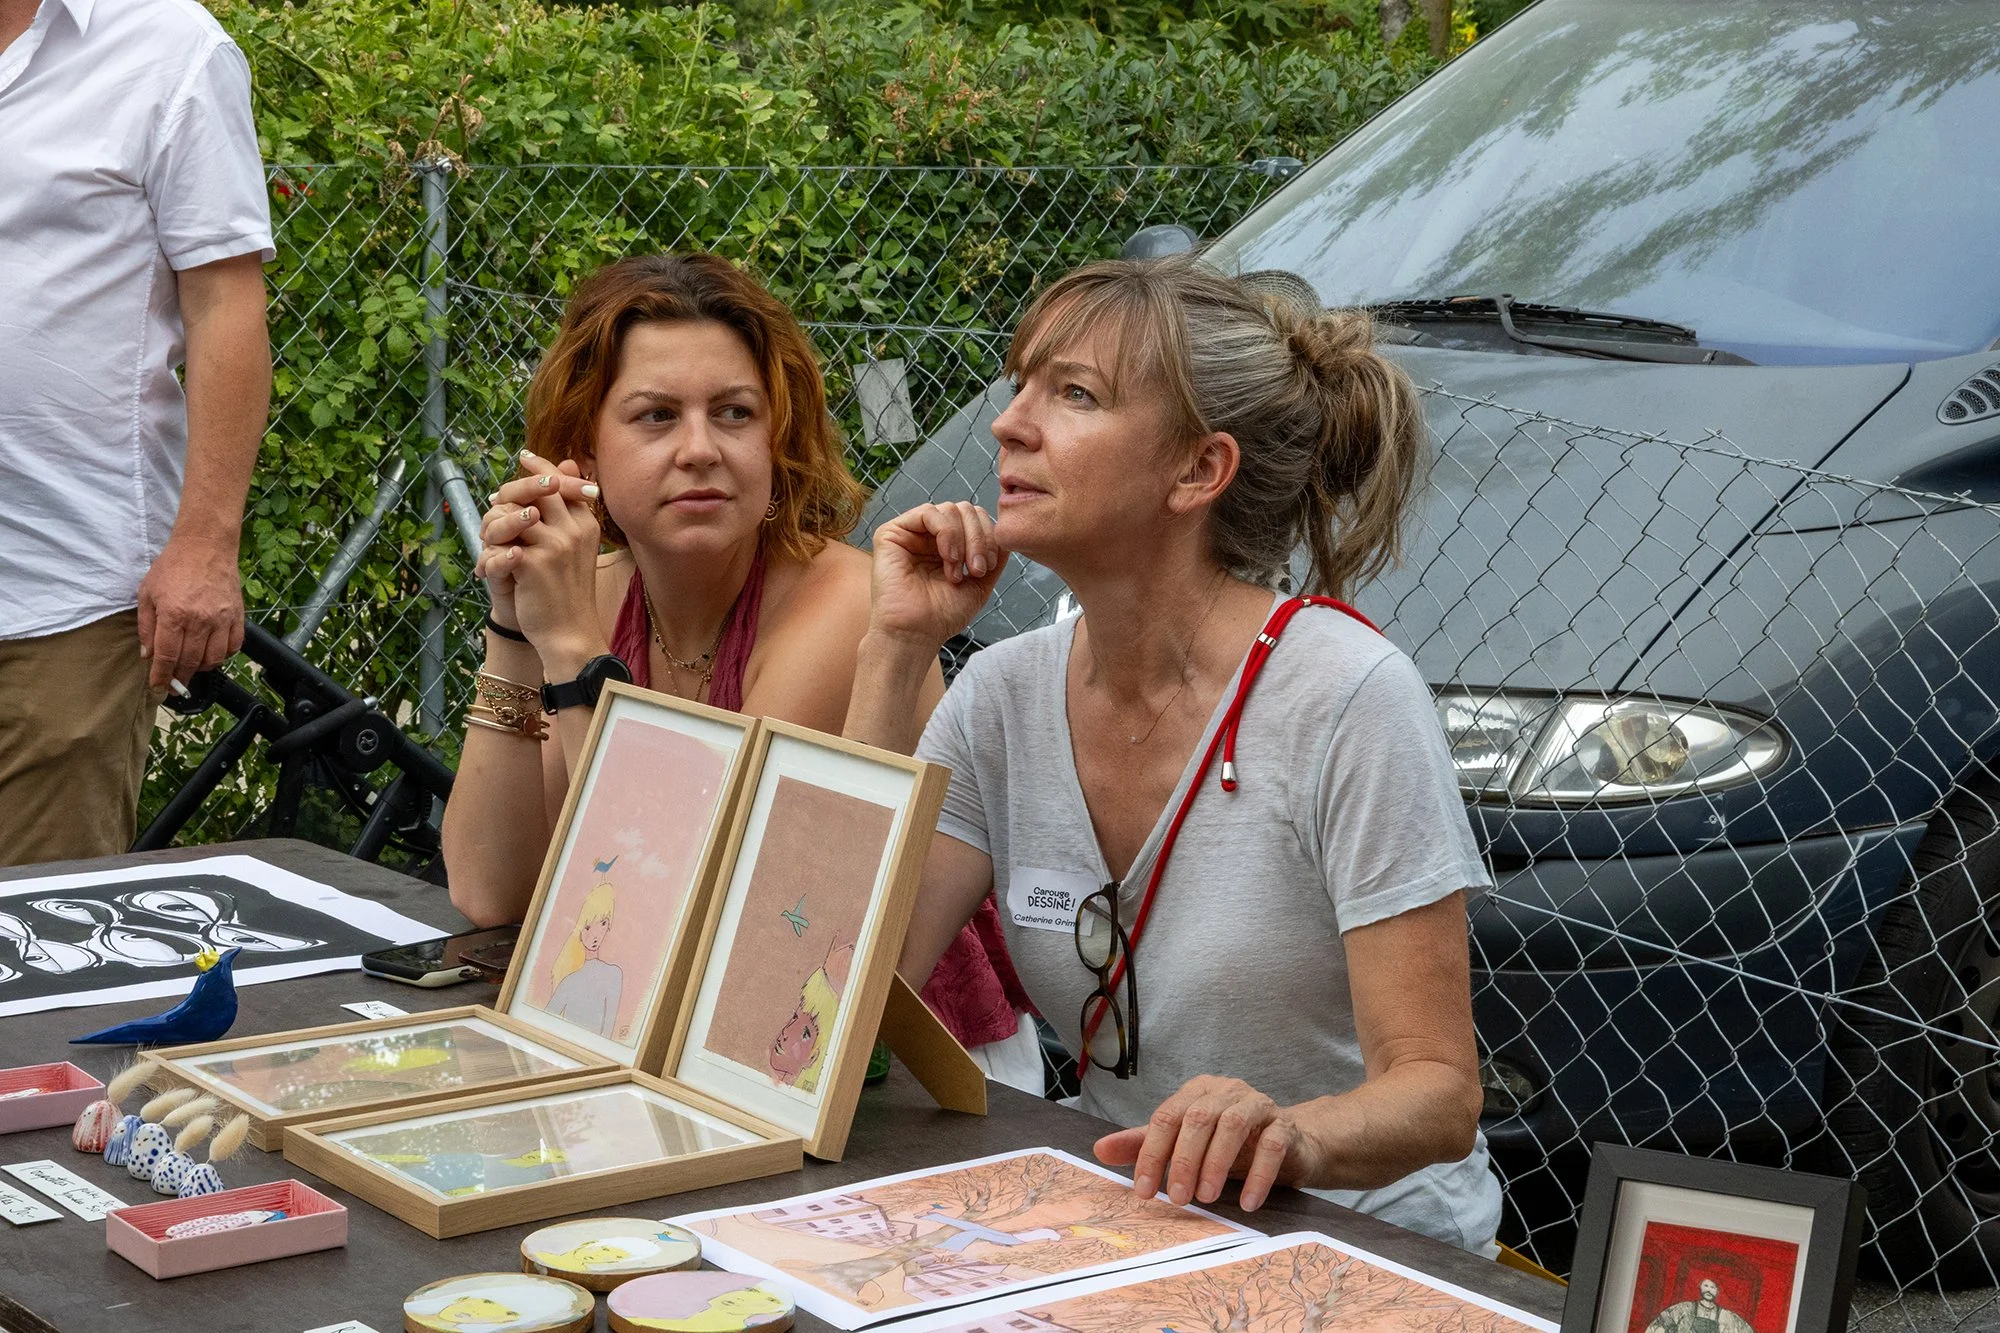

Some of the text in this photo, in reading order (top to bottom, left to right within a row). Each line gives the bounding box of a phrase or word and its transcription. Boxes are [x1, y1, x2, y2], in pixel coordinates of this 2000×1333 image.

[1033, 886, 1070, 899] Carouge
[1028, 895, 1076, 912] DESSINÉ!
[1014, 913, 1053, 925] Catherine
